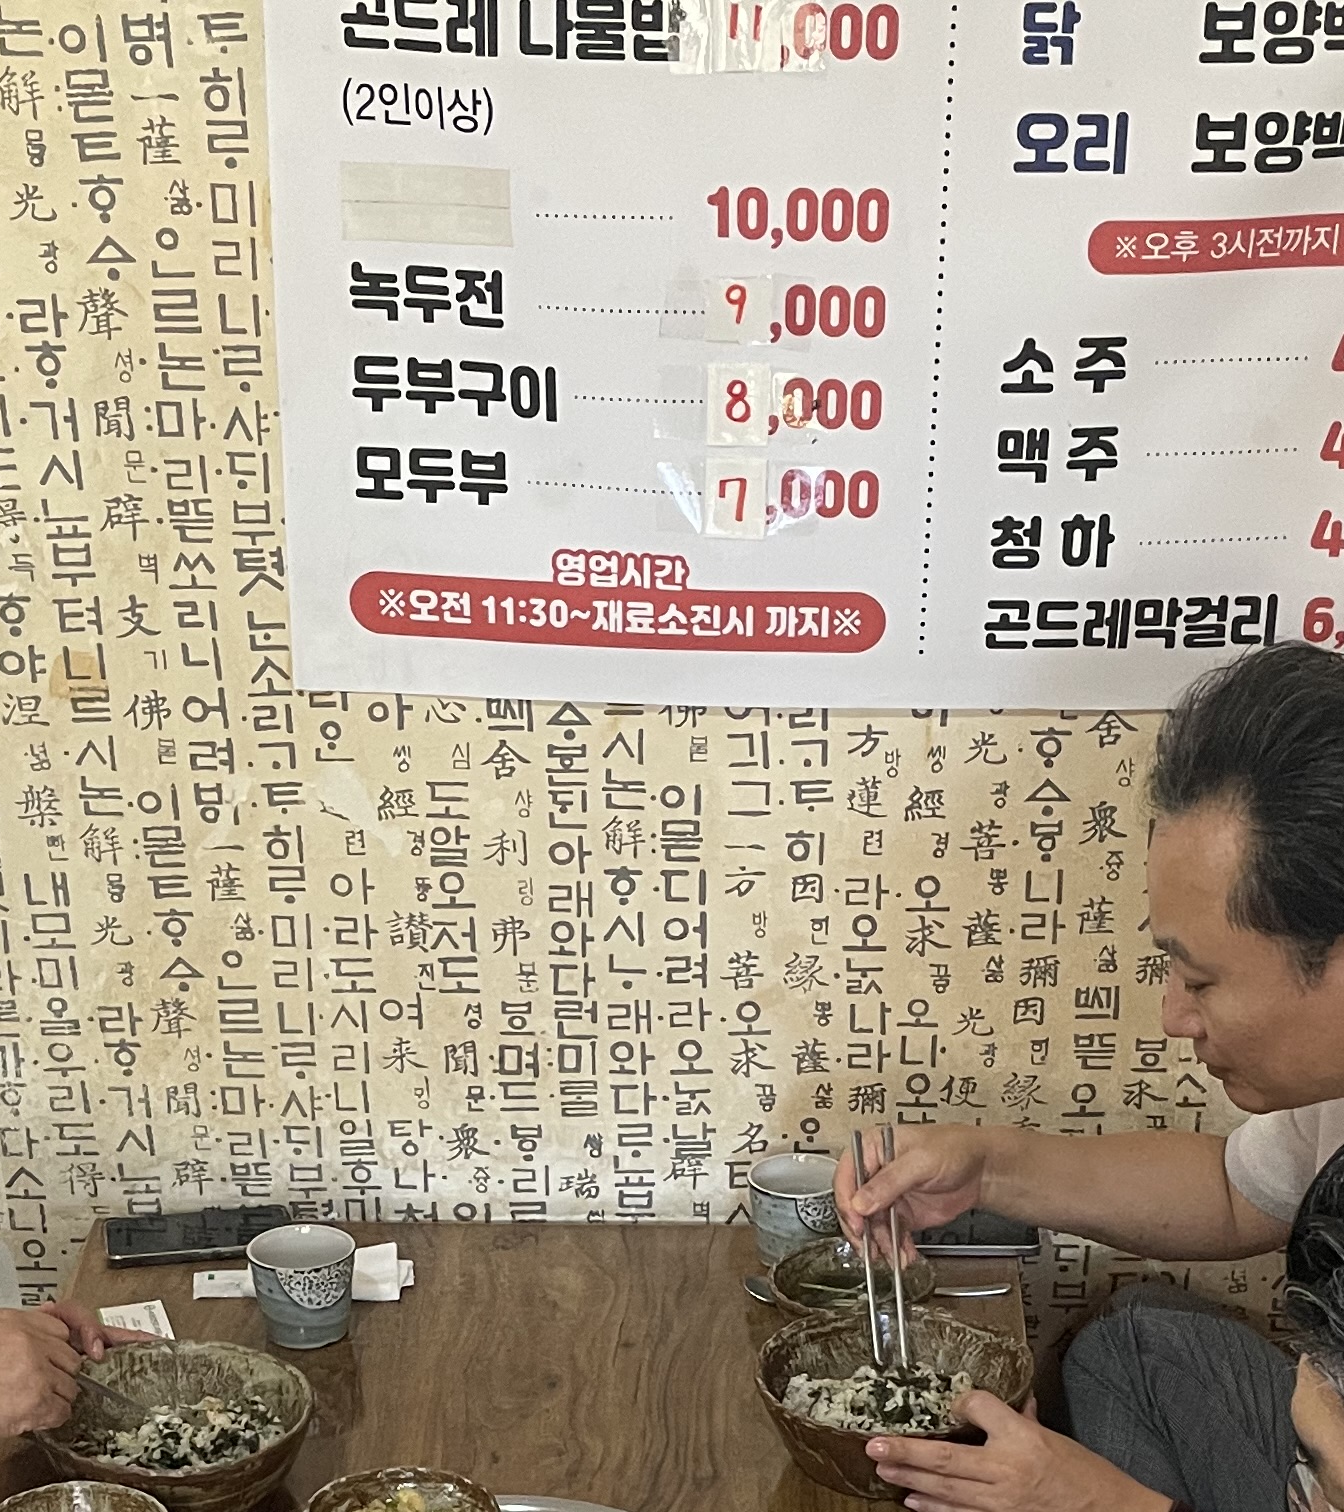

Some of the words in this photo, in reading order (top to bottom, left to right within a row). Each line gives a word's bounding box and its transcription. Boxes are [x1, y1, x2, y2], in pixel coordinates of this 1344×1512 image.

[1022, 0, 1082, 66] 닭
[342, 77, 494, 136] (2인이상)
[1013, 111, 1129, 175] 오리
[708, 187, 889, 248] 10,000
[1210, 222, 1341, 260] 3시전까지
[349, 261, 505, 329] 녹두전
[351, 355, 558, 423] 두부구이
[355, 445, 509, 506] 모두부
[555, 553, 688, 591] 영업시간
[484, 597, 755, 639] 11:30~재료소진시
[983, 593, 1279, 650] 곤드레막걸리
